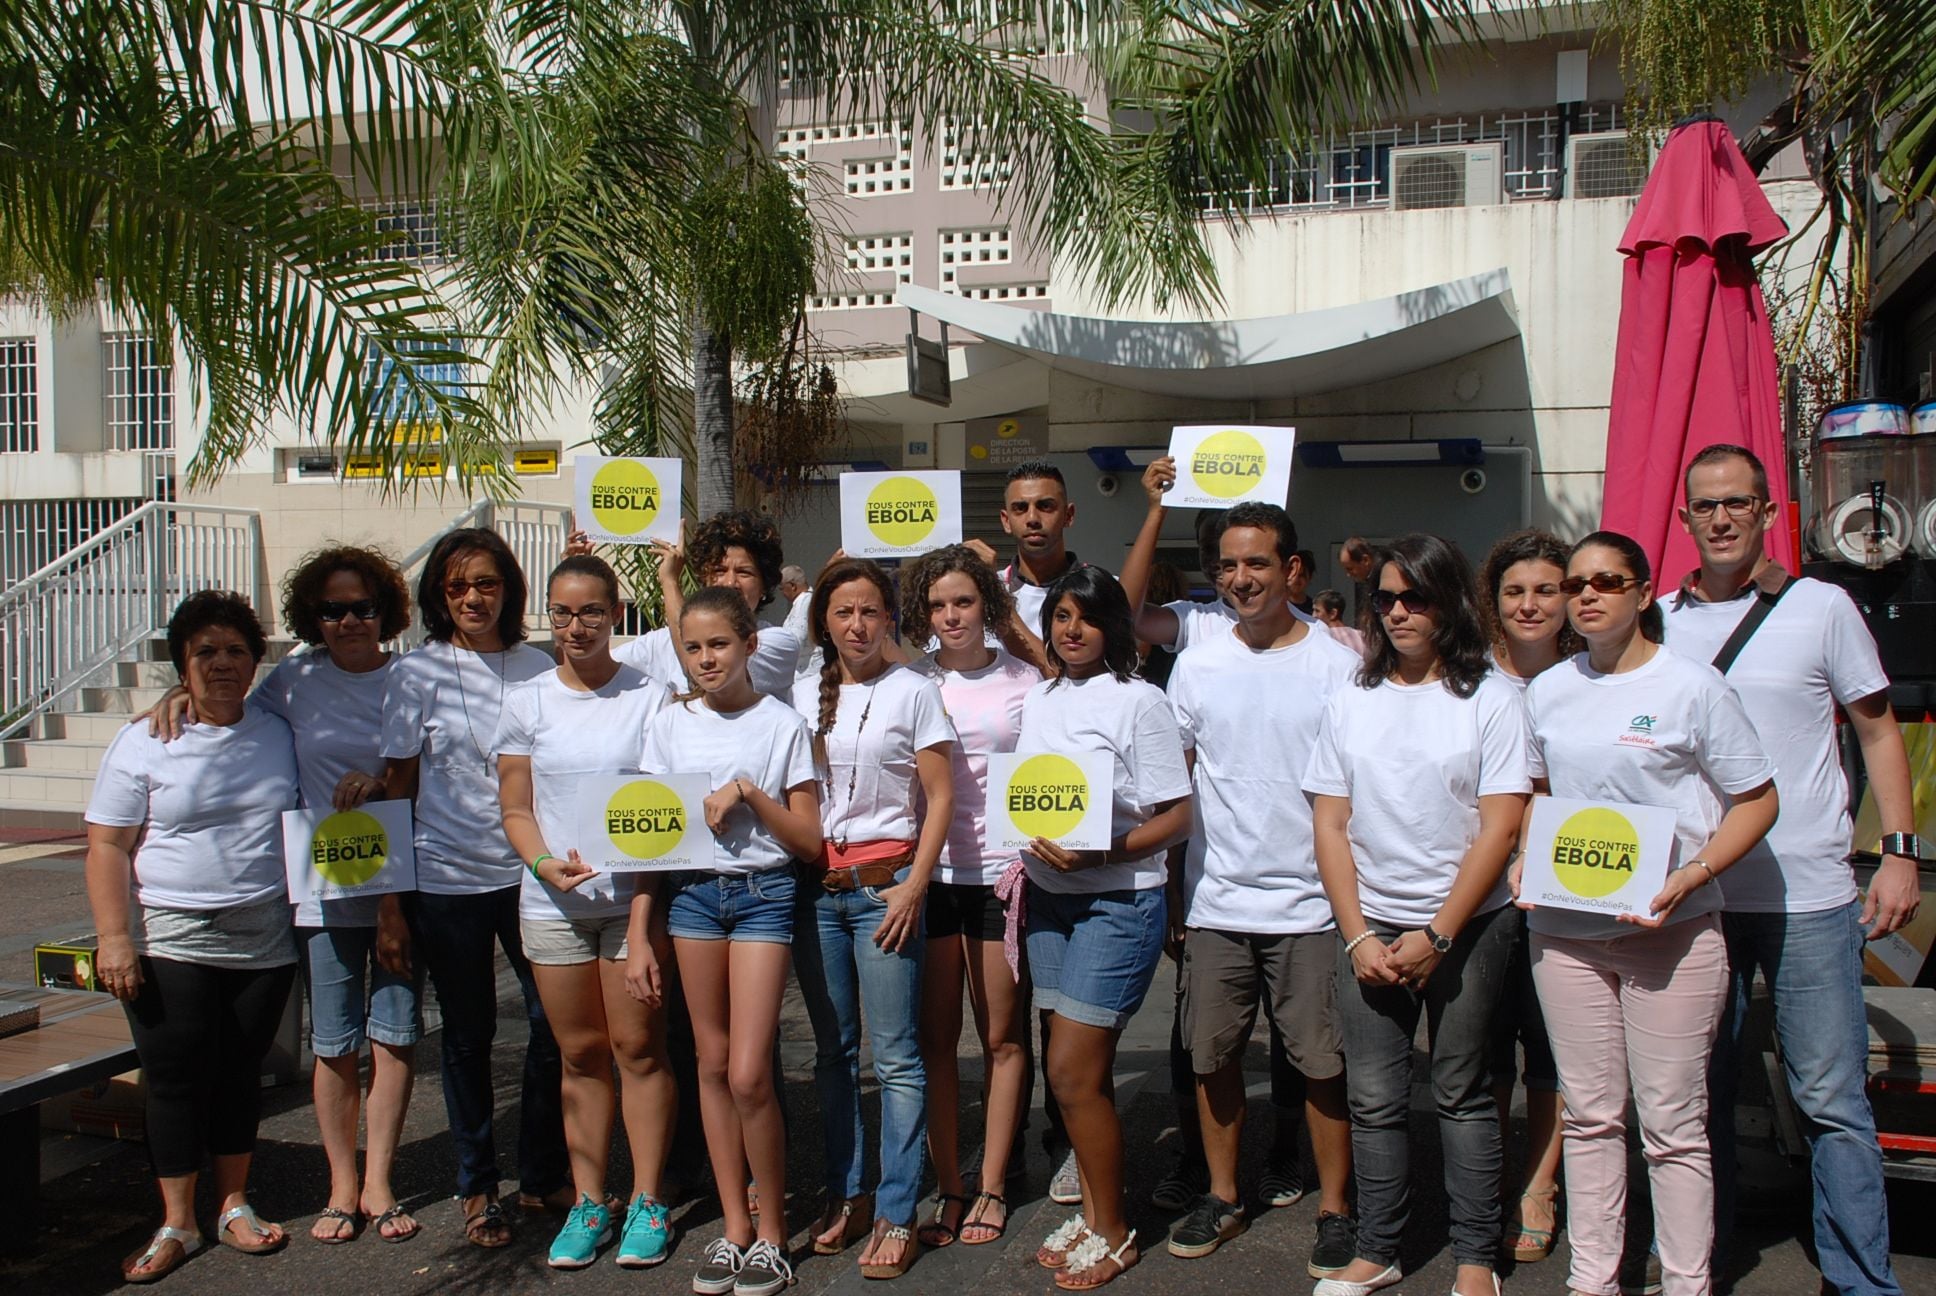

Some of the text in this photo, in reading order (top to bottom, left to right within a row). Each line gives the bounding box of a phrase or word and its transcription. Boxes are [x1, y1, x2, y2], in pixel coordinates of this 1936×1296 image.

[1013, 447, 1037, 455] POSTE
[1194, 452, 1264, 463] TOUS CONTRE
[1192, 460, 1262, 477] EBOLA
[592, 485, 658, 495] TOUS CONTRE
[592, 494, 657, 511] EBOLA
[868, 500, 935, 510] TOUS CONTRE
[868, 509, 935, 524] EBOLA
[1009, 784, 1086, 794] TOUS CONTRE
[1008, 794, 1085, 812] EBOLA
[607, 807, 683, 817] TOUS CONTRE
[608, 816, 683, 834] EBOLA
[312, 833, 385, 849] TOUS CONTRE
[1556, 836, 1637, 853] TOUS CONTRE
[313, 843, 385, 864] EBOLA
[1553, 846, 1634, 872] EBOLA
[604, 857, 691, 867] #OnNeVousOubliePas
[1541, 893, 1633, 911] #OnNeVousOubliePas
